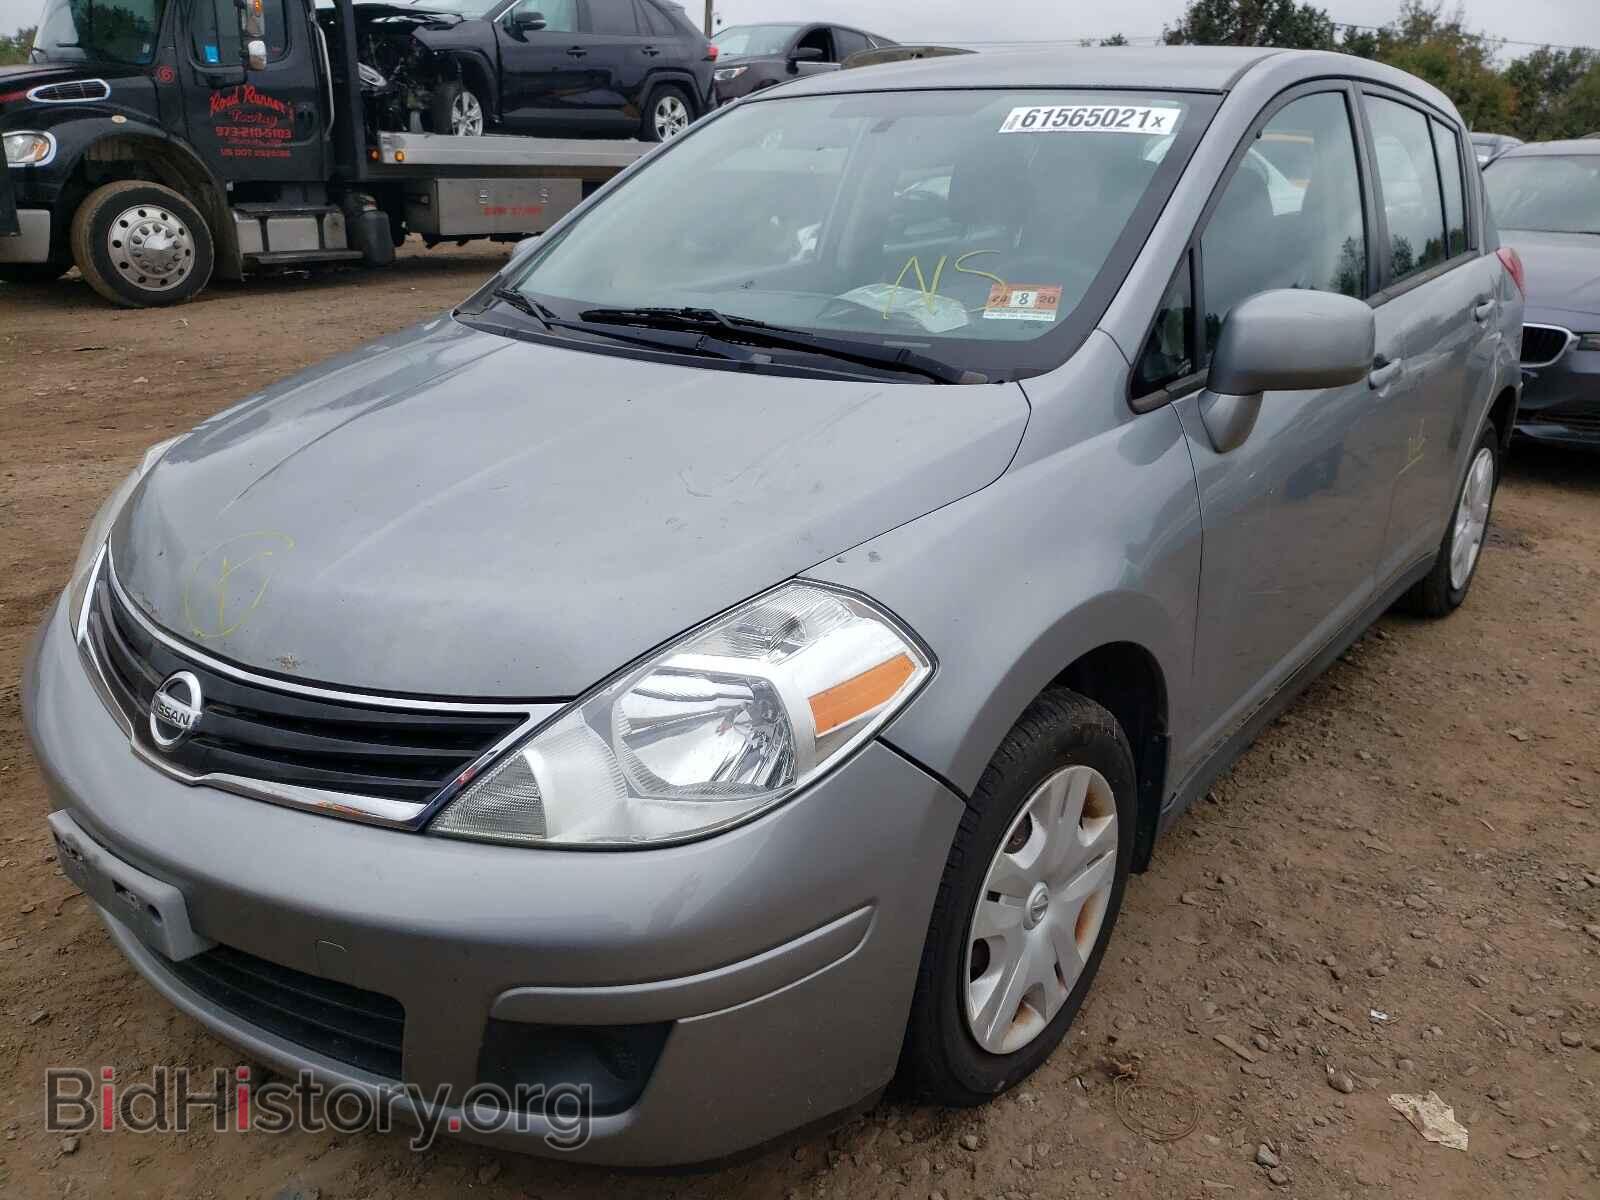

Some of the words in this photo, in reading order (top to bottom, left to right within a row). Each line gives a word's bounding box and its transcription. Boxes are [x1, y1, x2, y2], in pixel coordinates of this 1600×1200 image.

[209, 86, 241, 118] Road
[1018, 292, 1030, 305] 8
[1039, 295, 1057, 304] 20
